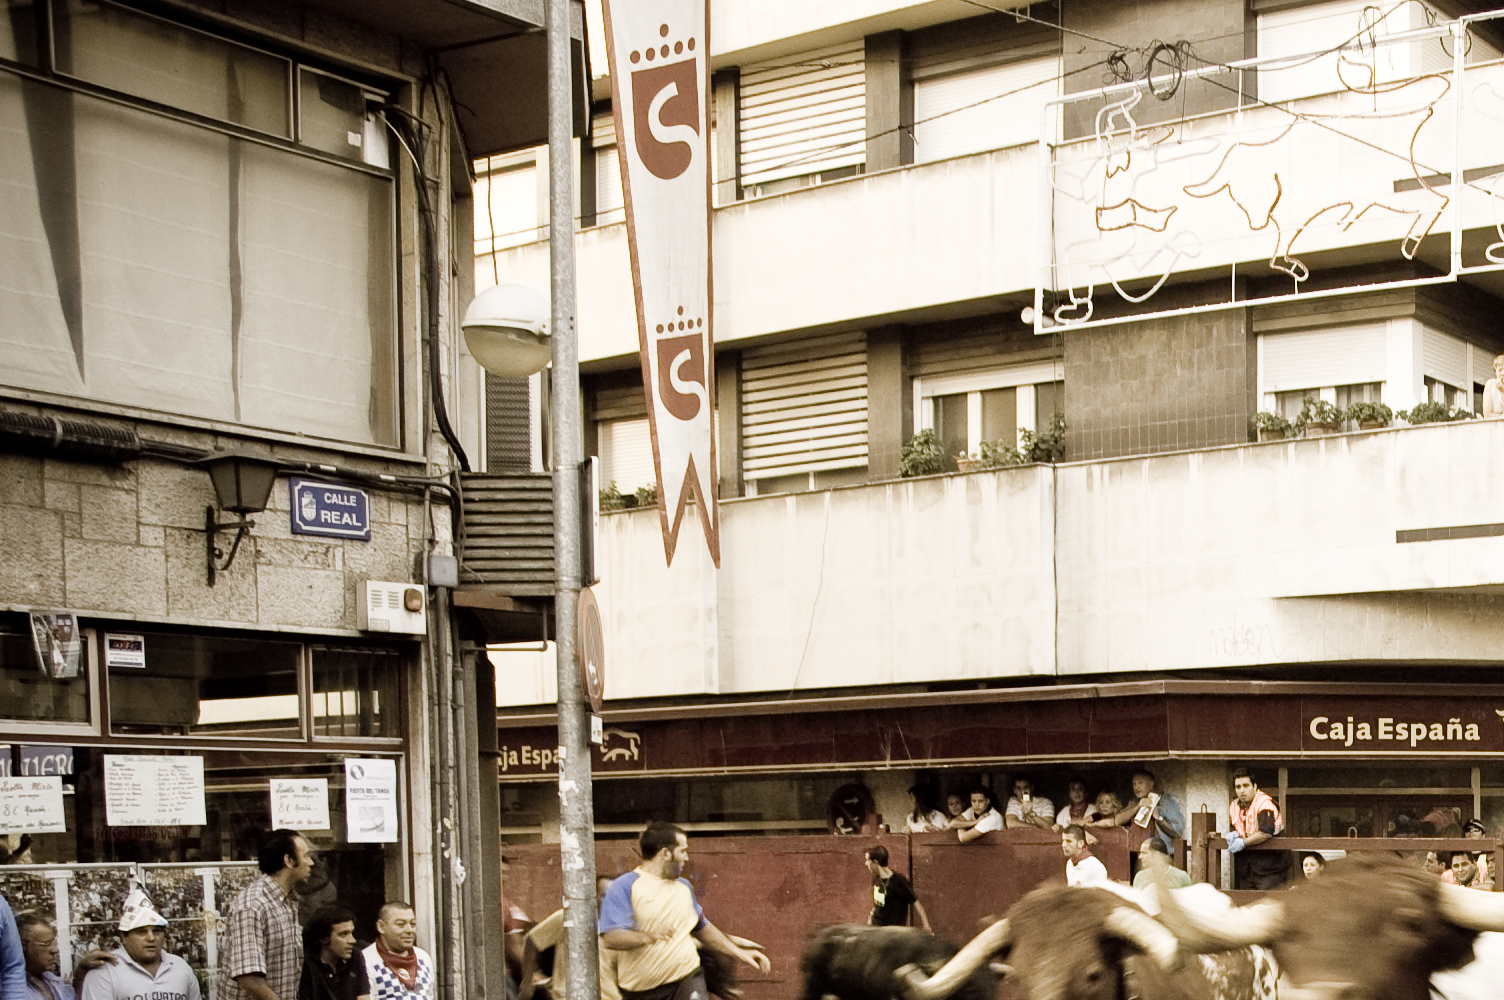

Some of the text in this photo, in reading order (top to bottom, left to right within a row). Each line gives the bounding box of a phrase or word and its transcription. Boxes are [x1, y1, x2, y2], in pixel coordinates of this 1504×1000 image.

[324, 491, 358, 507] CALLE
[320, 509, 363, 527] REAL
[1309, 716, 1481, 748] Caja España
[521, 744, 560, 771] Espa
